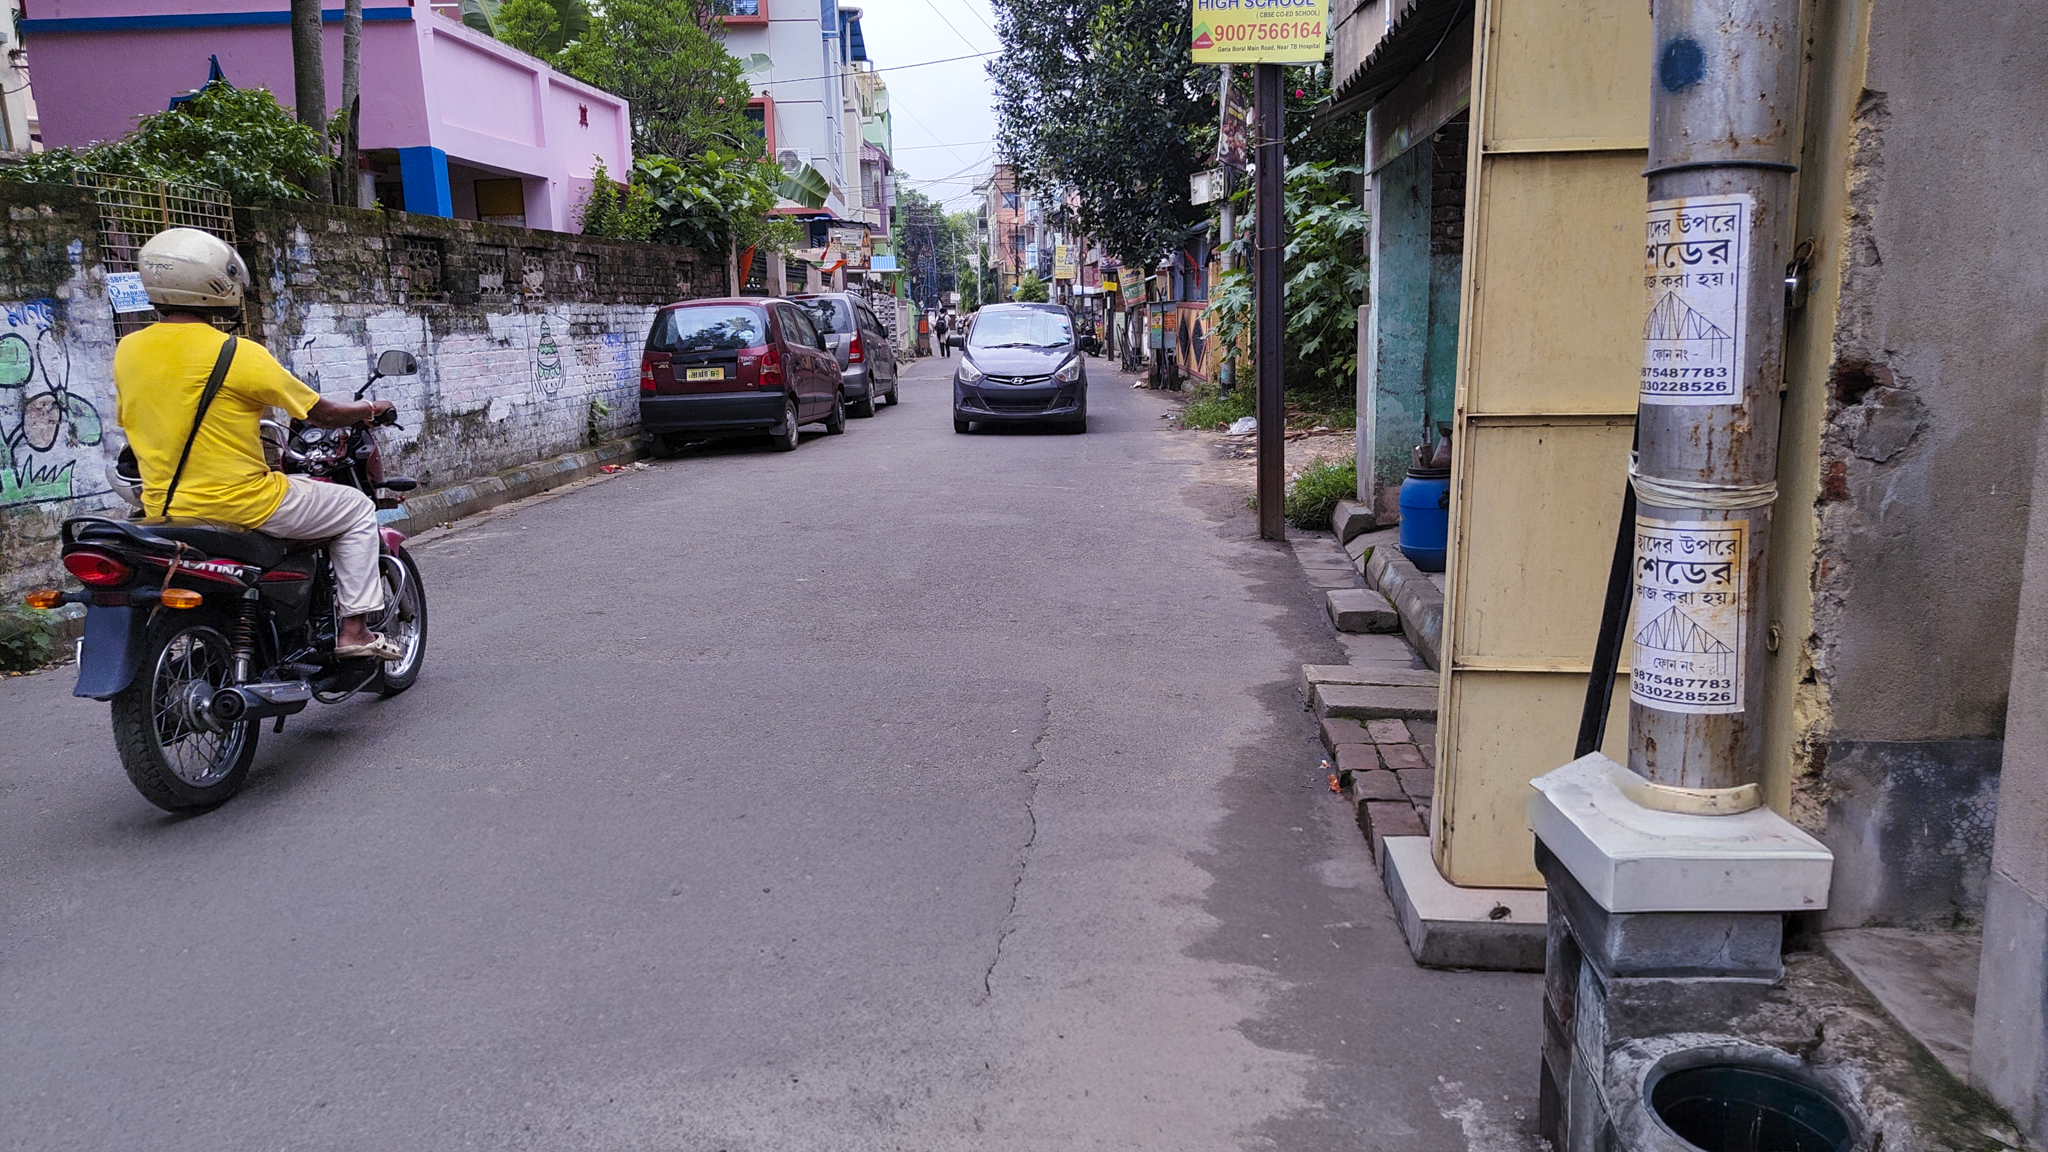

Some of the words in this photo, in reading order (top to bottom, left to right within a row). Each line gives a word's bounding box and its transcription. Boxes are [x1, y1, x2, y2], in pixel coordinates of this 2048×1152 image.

[1214, 21, 1322, 42] 9007566164
[1676, 213, 1736, 233] উপরে
[1660, 272, 1690, 288] করা
[1652, 349, 1672, 361] ফোন
[1640, 367, 1727, 378] 875487783
[1640, 380, 1727, 392] 330228526
[1678, 533, 1737, 556] উপরে
[1636, 556, 1734, 585] শেডের
[1635, 583, 1657, 601] কাজ
[1661, 588, 1695, 605] করা
[1653, 657, 1677, 671] ফোন
[1633, 667, 1731, 689] 9875487783
[1633, 680, 1731, 701] 9330228526
